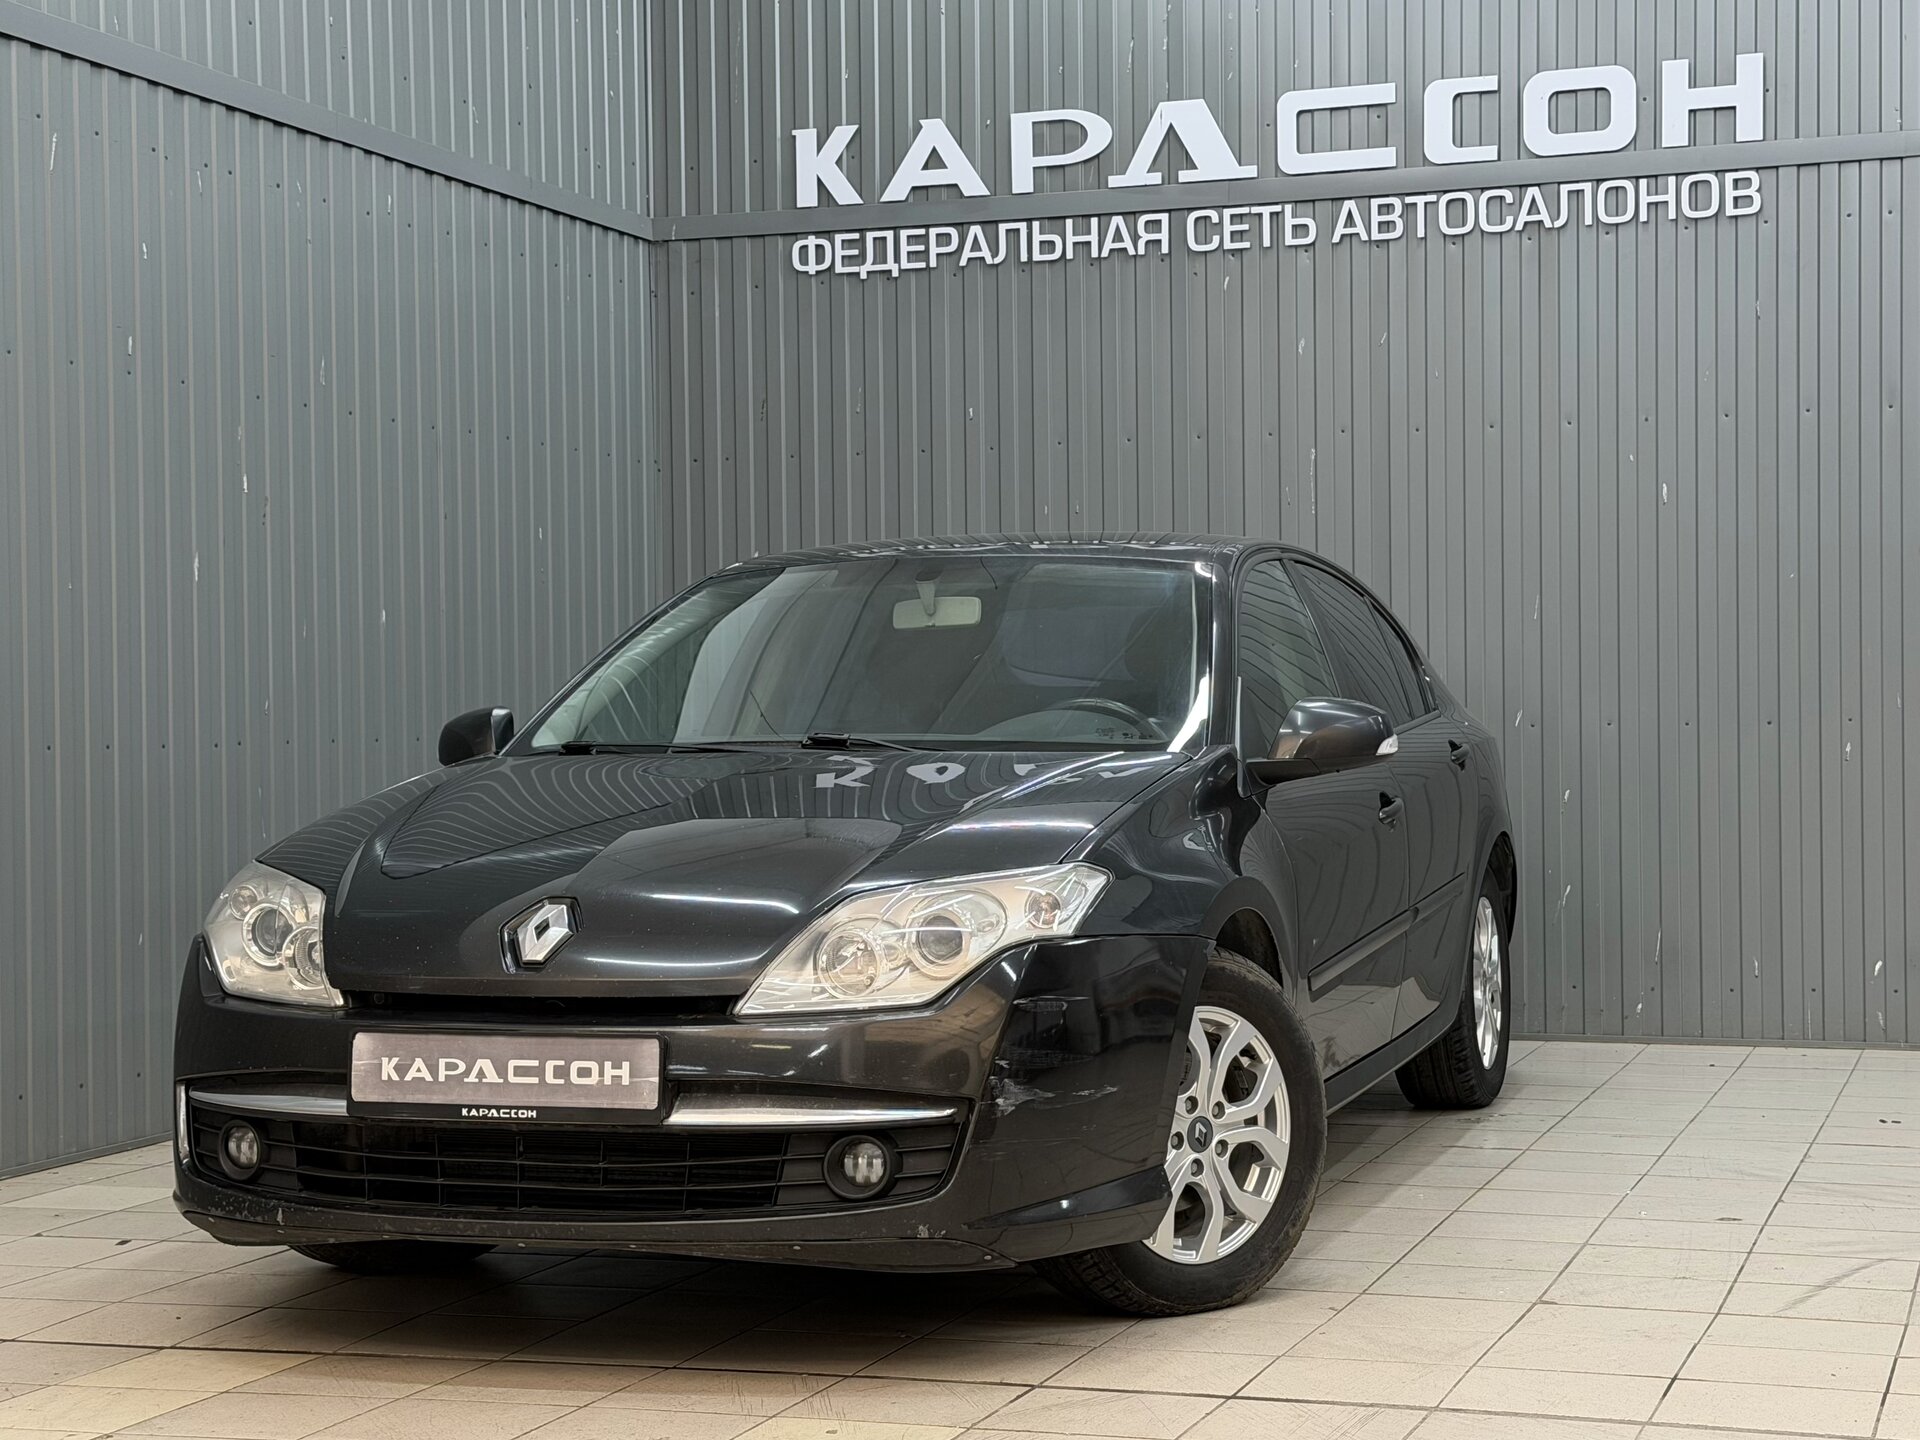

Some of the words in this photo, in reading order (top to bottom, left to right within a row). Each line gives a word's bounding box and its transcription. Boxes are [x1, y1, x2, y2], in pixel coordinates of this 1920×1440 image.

[791, 212, 1171, 280] ФЕДЕРАЛЬНАЯ
[1186, 203, 1317, 253] СЕТЬ
[1331, 169, 1762, 244] АВТОСАЛОНОВ
